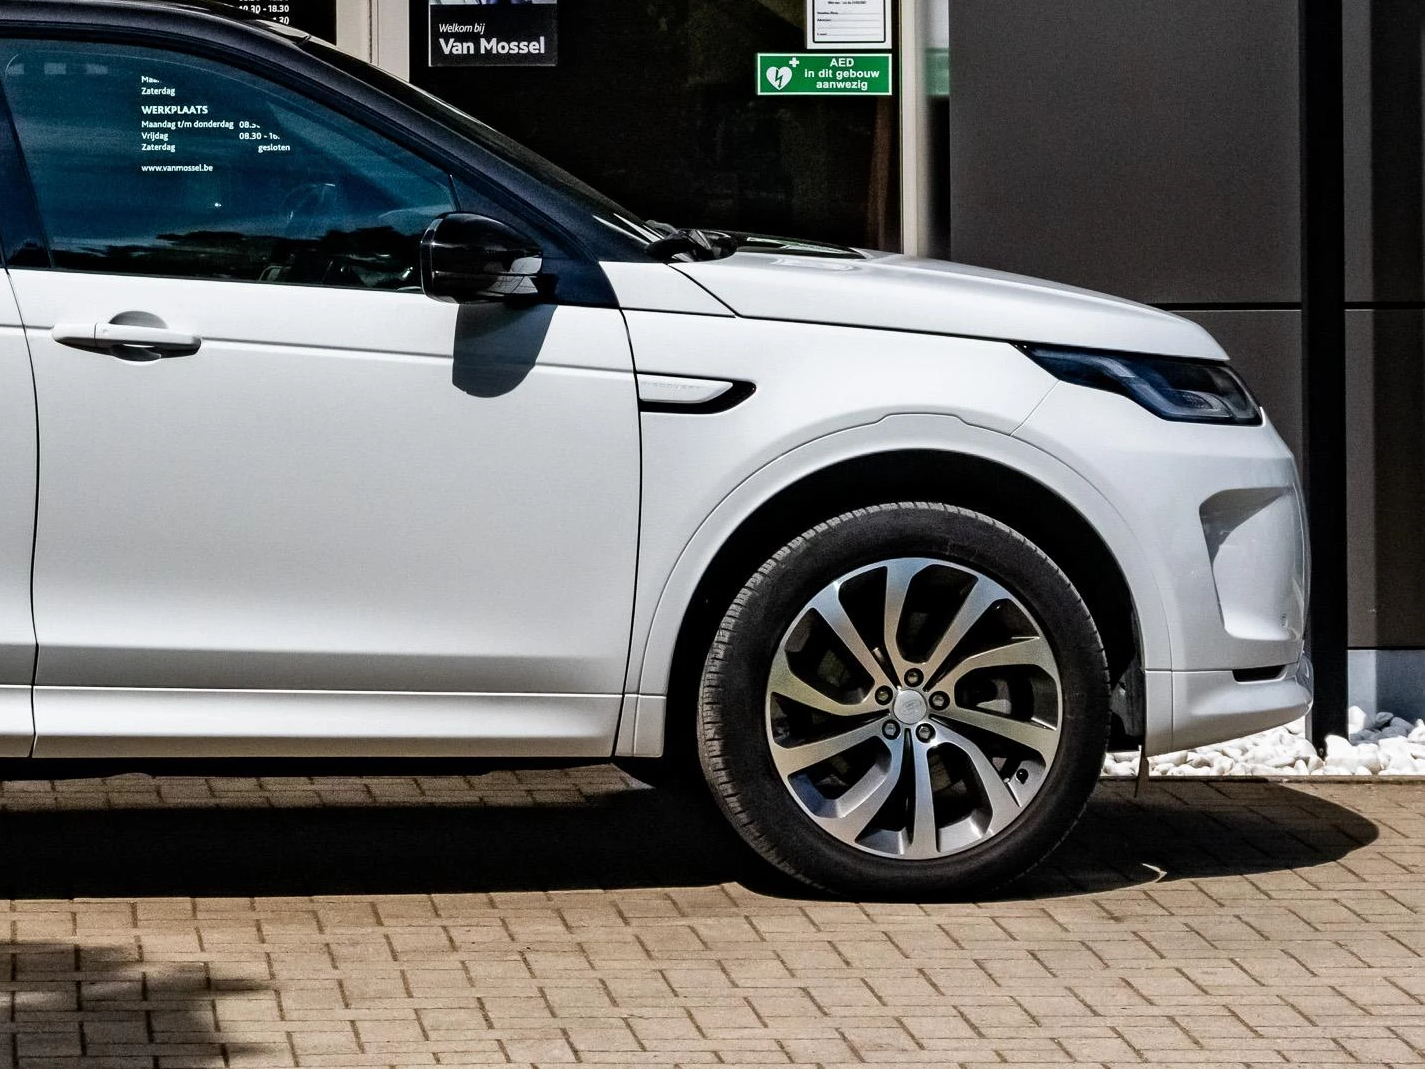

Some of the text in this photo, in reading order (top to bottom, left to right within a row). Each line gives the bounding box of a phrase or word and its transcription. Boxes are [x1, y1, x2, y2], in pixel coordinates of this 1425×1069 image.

[267, 5, 290, 13] 18.30
[439, 22, 486, 35] Welkom bij
[438, 36, 545, 55] Van Mossel
[829, 58, 855, 67] AED
[804, 68, 880, 80] in dit gebouw
[816, 80, 868, 90] aanwezig
[141, 87, 175, 96] Zaterdag
[141, 105, 209, 115] WERKPLAATS
[141, 120, 175, 130] Maandag
[177, 120, 192, 129] t/m
[193, 120, 235, 130] donderdag
[141, 132, 169, 142] Vrijdag
[238, 132, 262, 140] 08.30
[141, 143, 291, 154] Zaterdag gesloten
[141, 163, 214, 172] www.vanmossel.be
